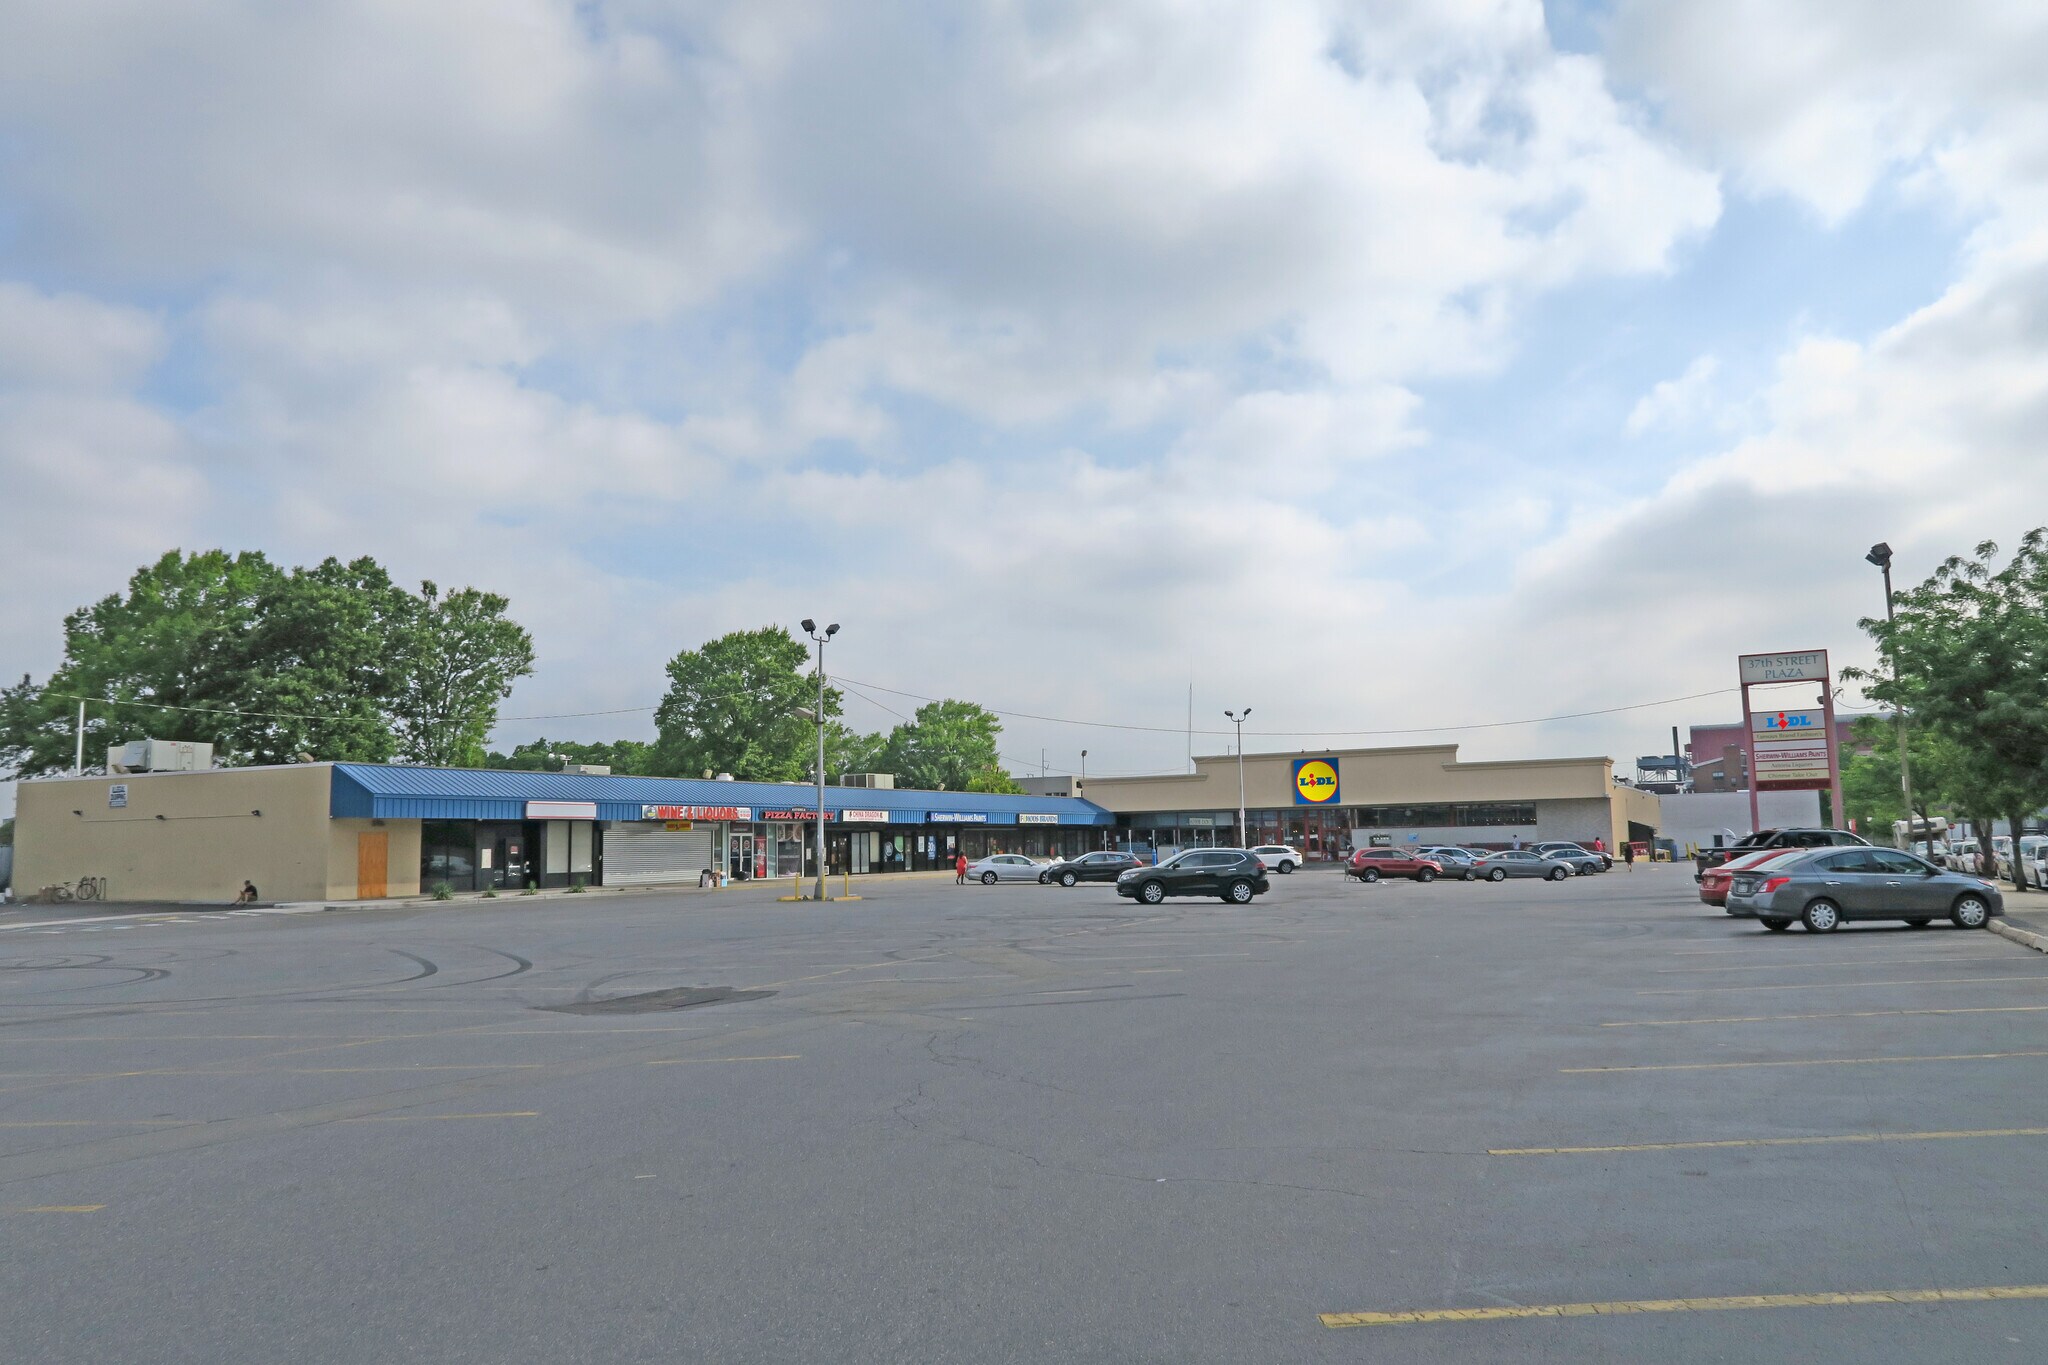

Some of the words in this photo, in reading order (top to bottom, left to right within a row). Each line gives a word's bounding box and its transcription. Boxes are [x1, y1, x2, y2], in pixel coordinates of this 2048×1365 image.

[1748, 658, 1772, 669] 37th
[1777, 655, 1818, 666] STREET
[1765, 668, 1804, 679] PLAZA
[657, 806, 684, 819] WINE
[687, 806, 694, 819] &
[697, 806, 738, 820] LIQUORS
[764, 811, 793, 819] PIZZA
[794, 812, 835, 820] FACTRY
